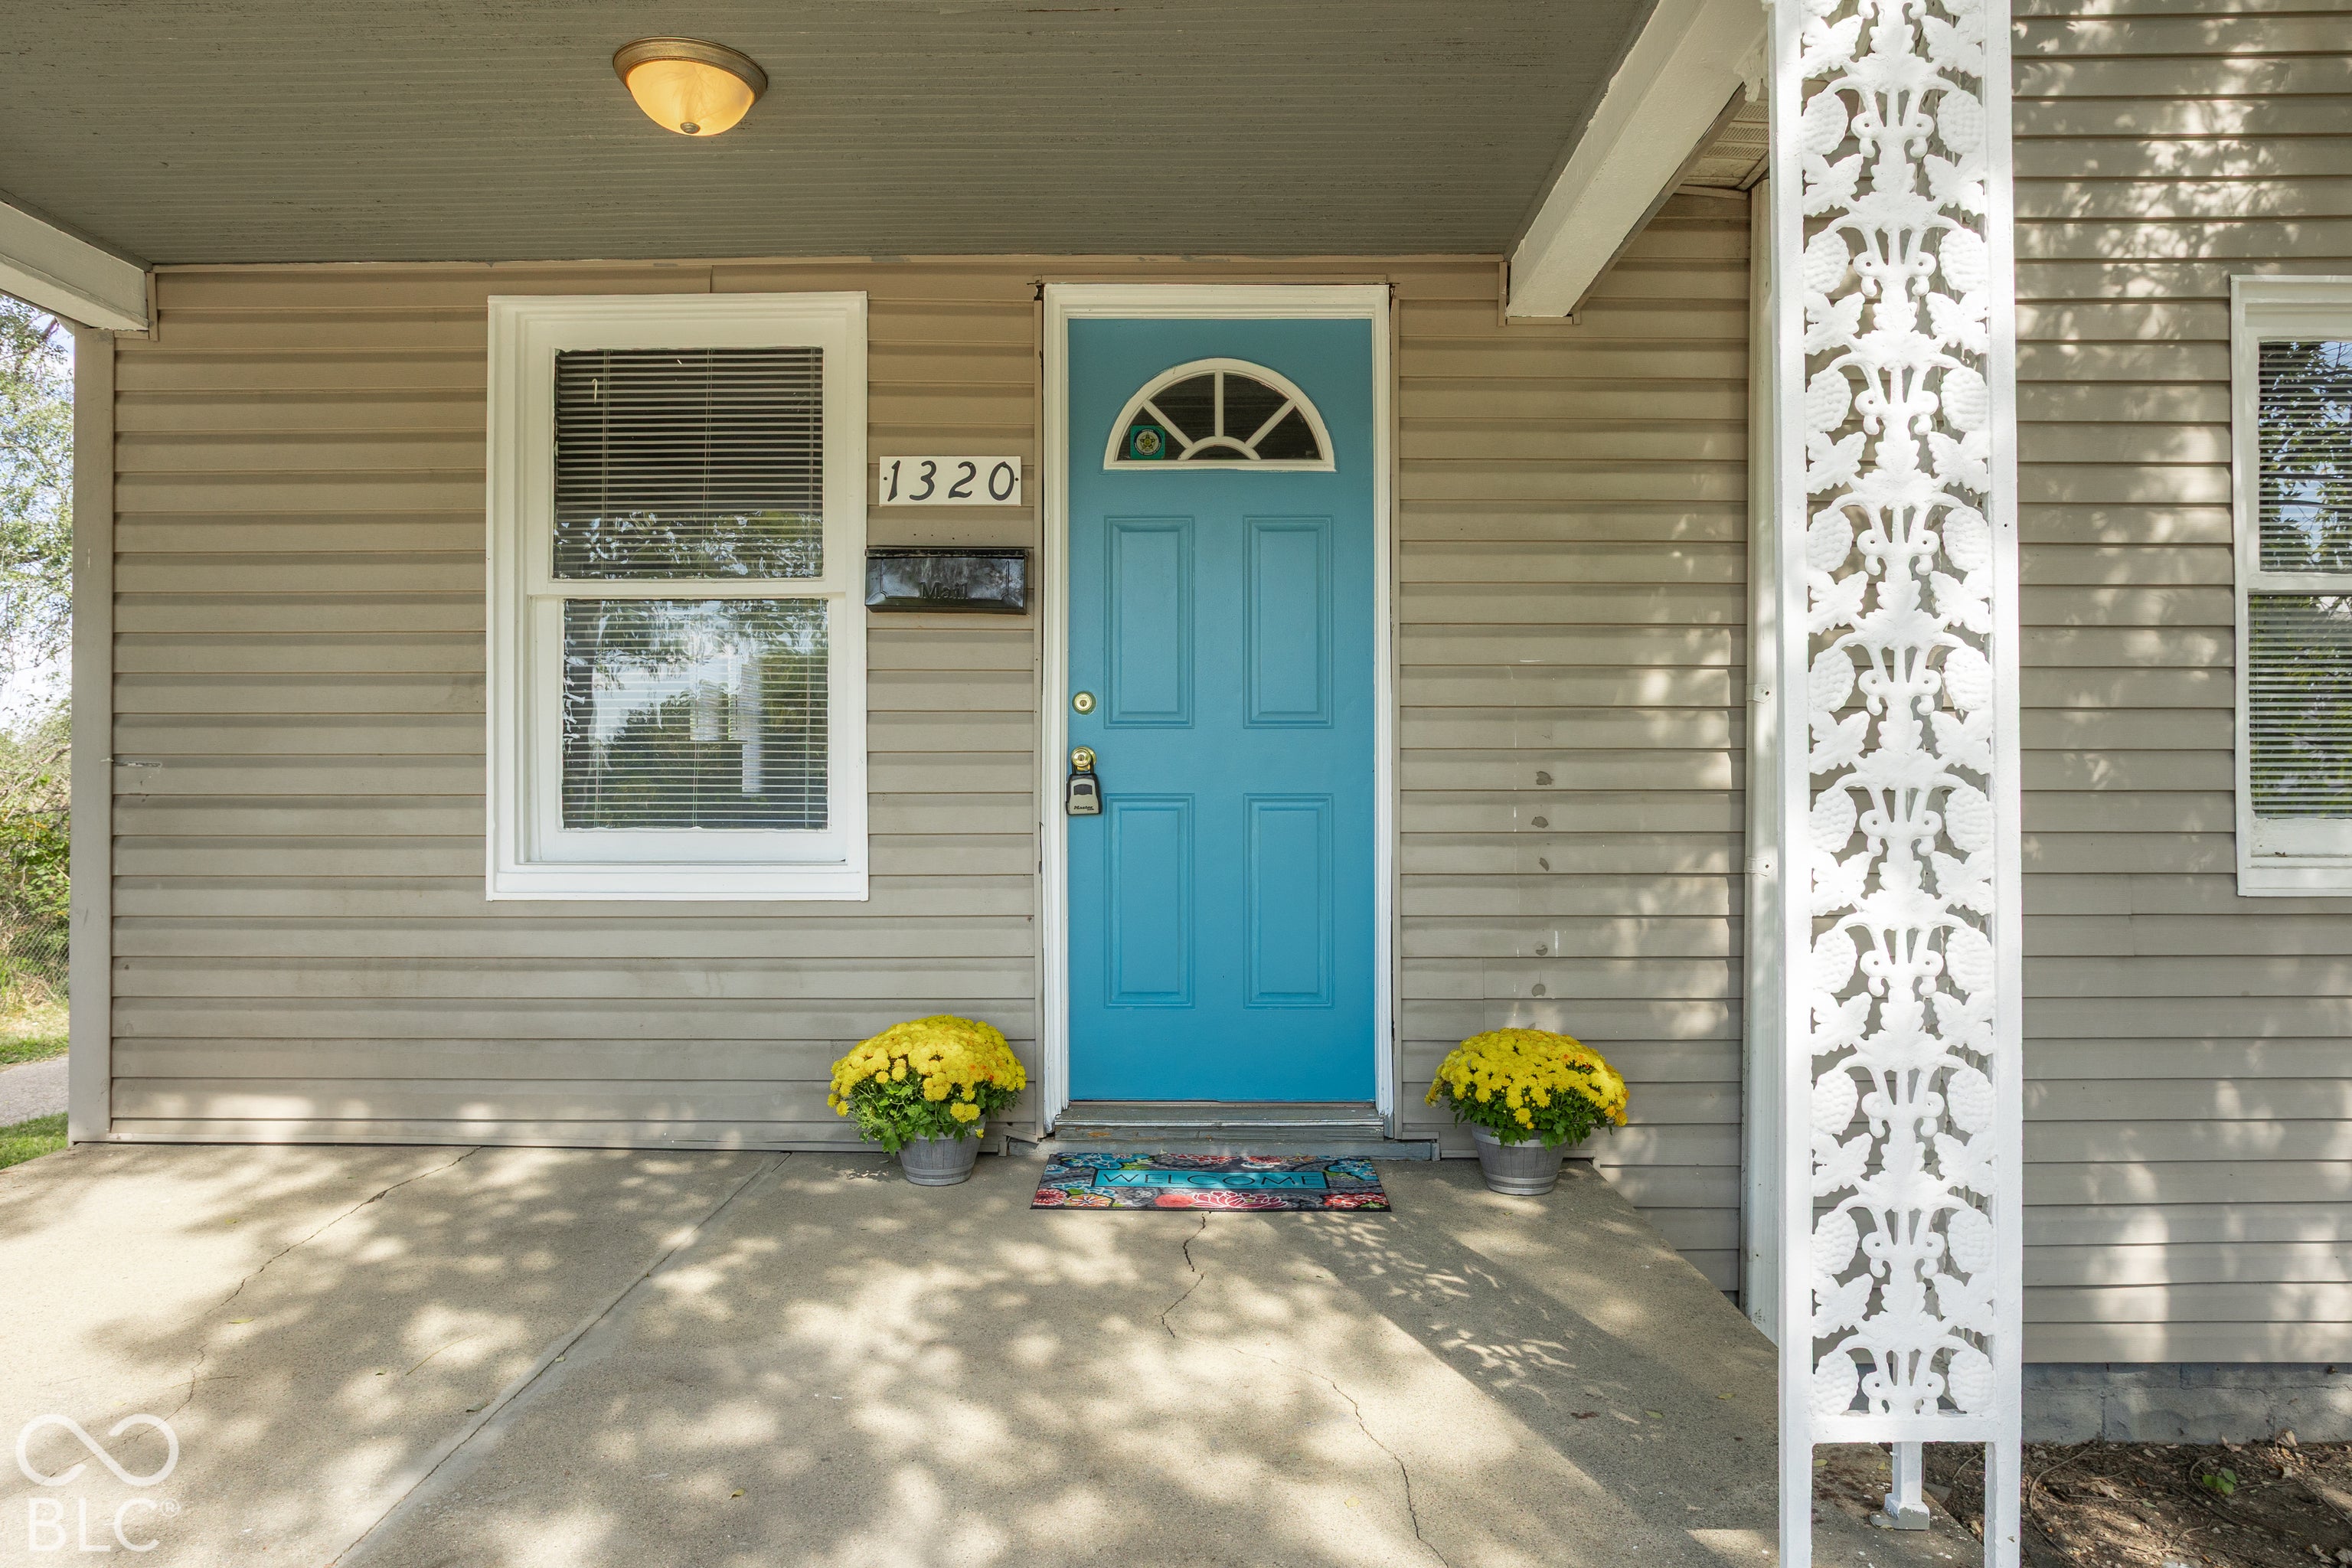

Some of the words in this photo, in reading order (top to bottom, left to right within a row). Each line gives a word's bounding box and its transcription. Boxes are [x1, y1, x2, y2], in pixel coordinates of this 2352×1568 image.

[887, 459, 1015, 501] 1320
[919, 581, 969, 599] Mail
[1102, 1173, 1322, 1186] WELCOME
